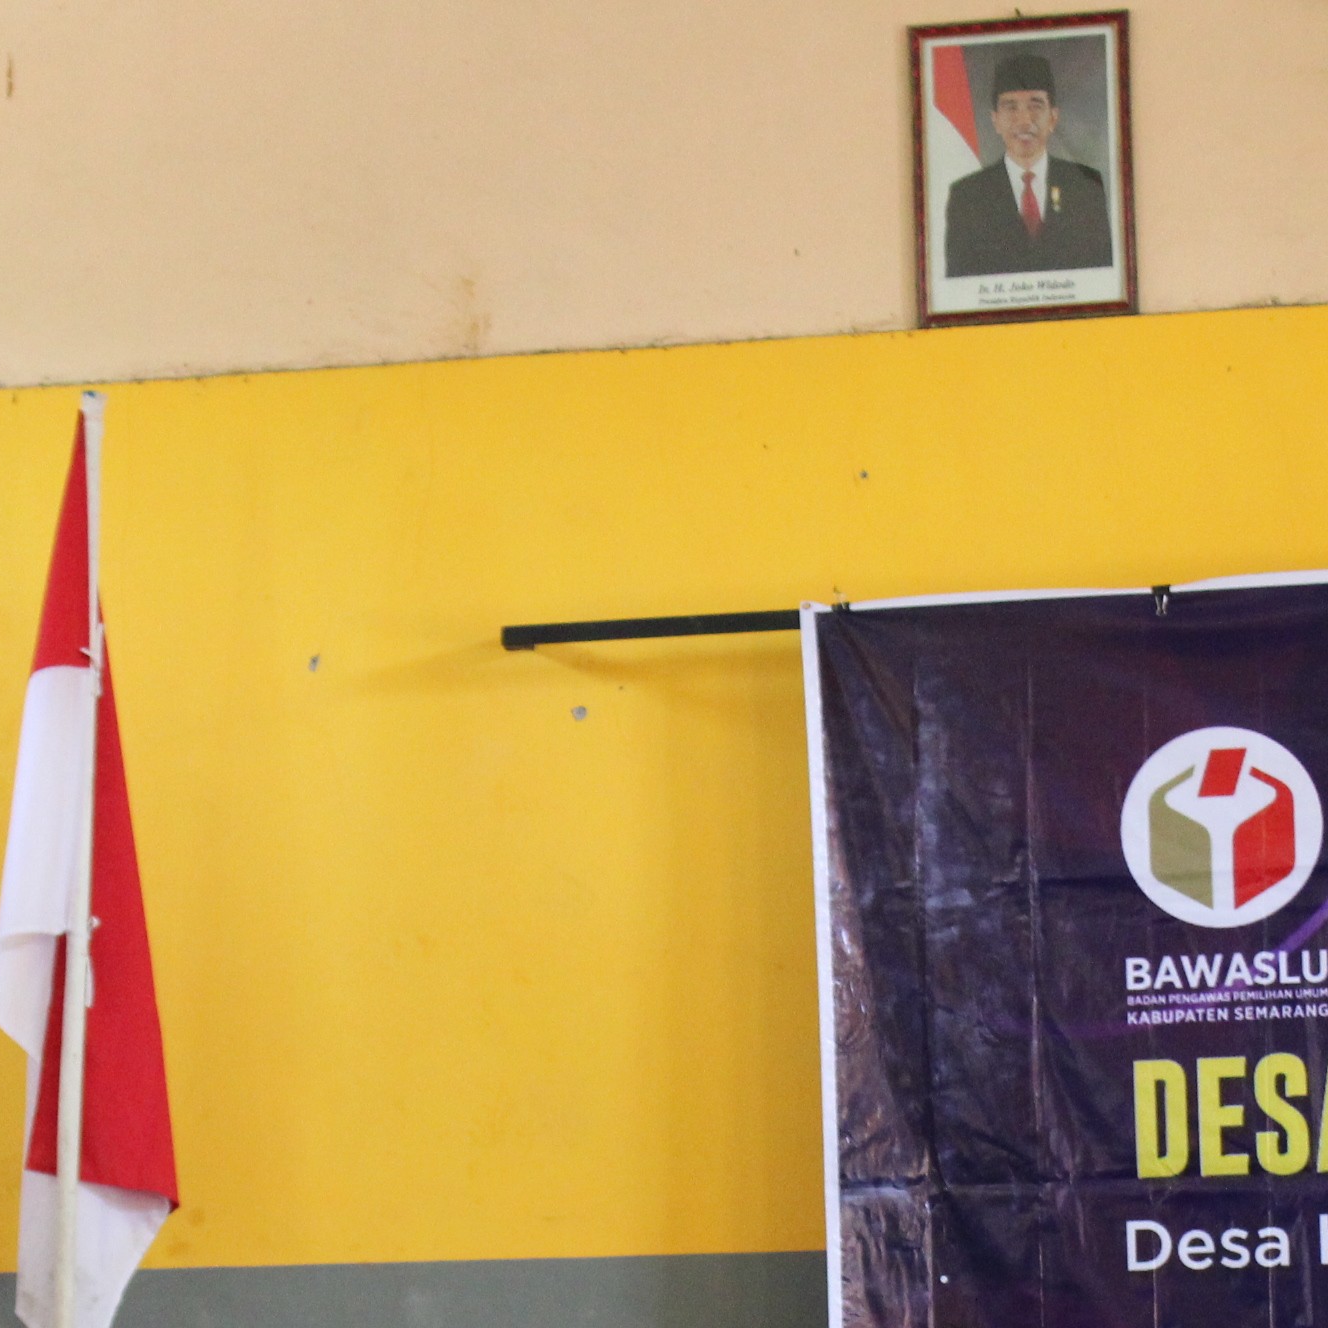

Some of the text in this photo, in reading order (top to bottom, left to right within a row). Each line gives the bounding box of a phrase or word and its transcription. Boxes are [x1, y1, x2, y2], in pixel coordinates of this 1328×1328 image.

[1125, 949, 1328, 990] BAWASLU
[1126, 987, 1328, 1006] BADAN PENGAWAS PEMILIHAN UMUM
[1127, 1007, 1229, 1025] KABUPATEN
[1126, 1220, 1290, 1272] Desa
